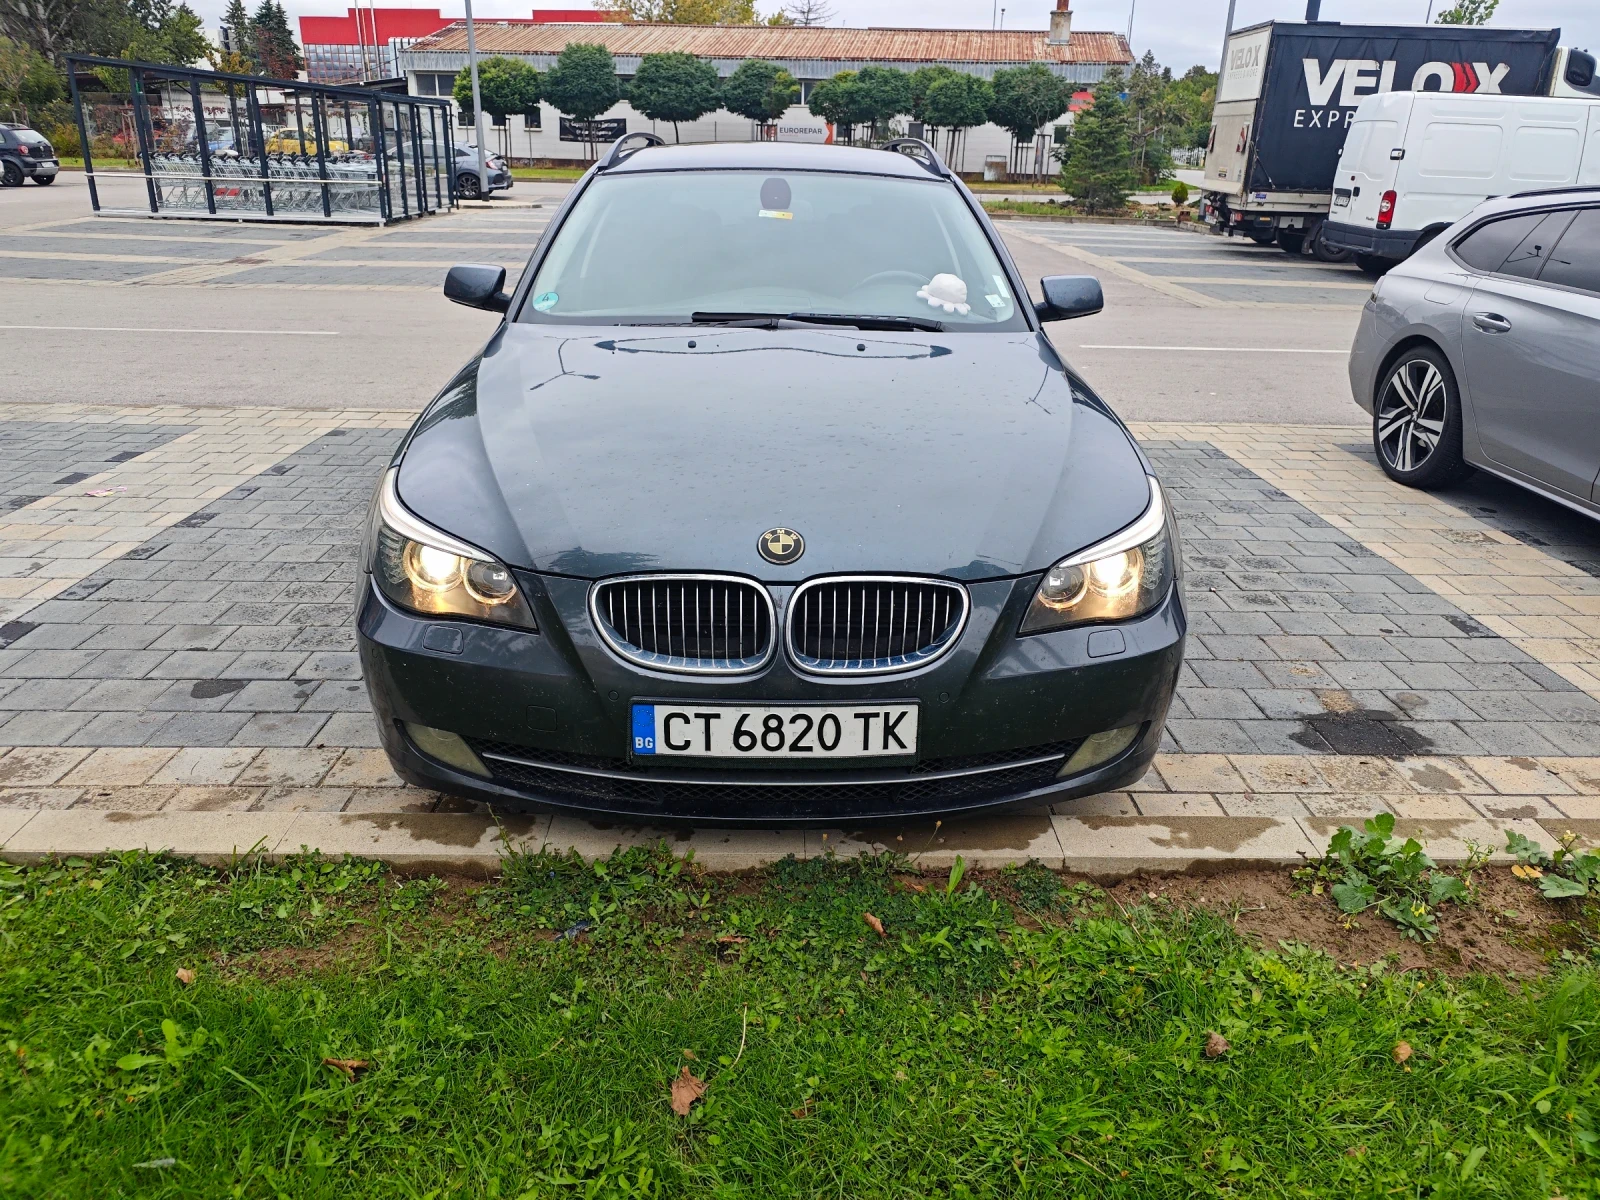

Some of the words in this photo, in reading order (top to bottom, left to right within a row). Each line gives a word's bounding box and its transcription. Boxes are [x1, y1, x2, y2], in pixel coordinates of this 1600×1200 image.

[1230, 44, 1261, 70] VELOX
[779, 127, 823, 135] EUROREPAR
[764, 529, 798, 540] BMW
[663, 712, 721, 752] CT
[733, 713, 842, 752] 6820
[853, 711, 909, 750] TK
[635, 737, 653, 749] BG
